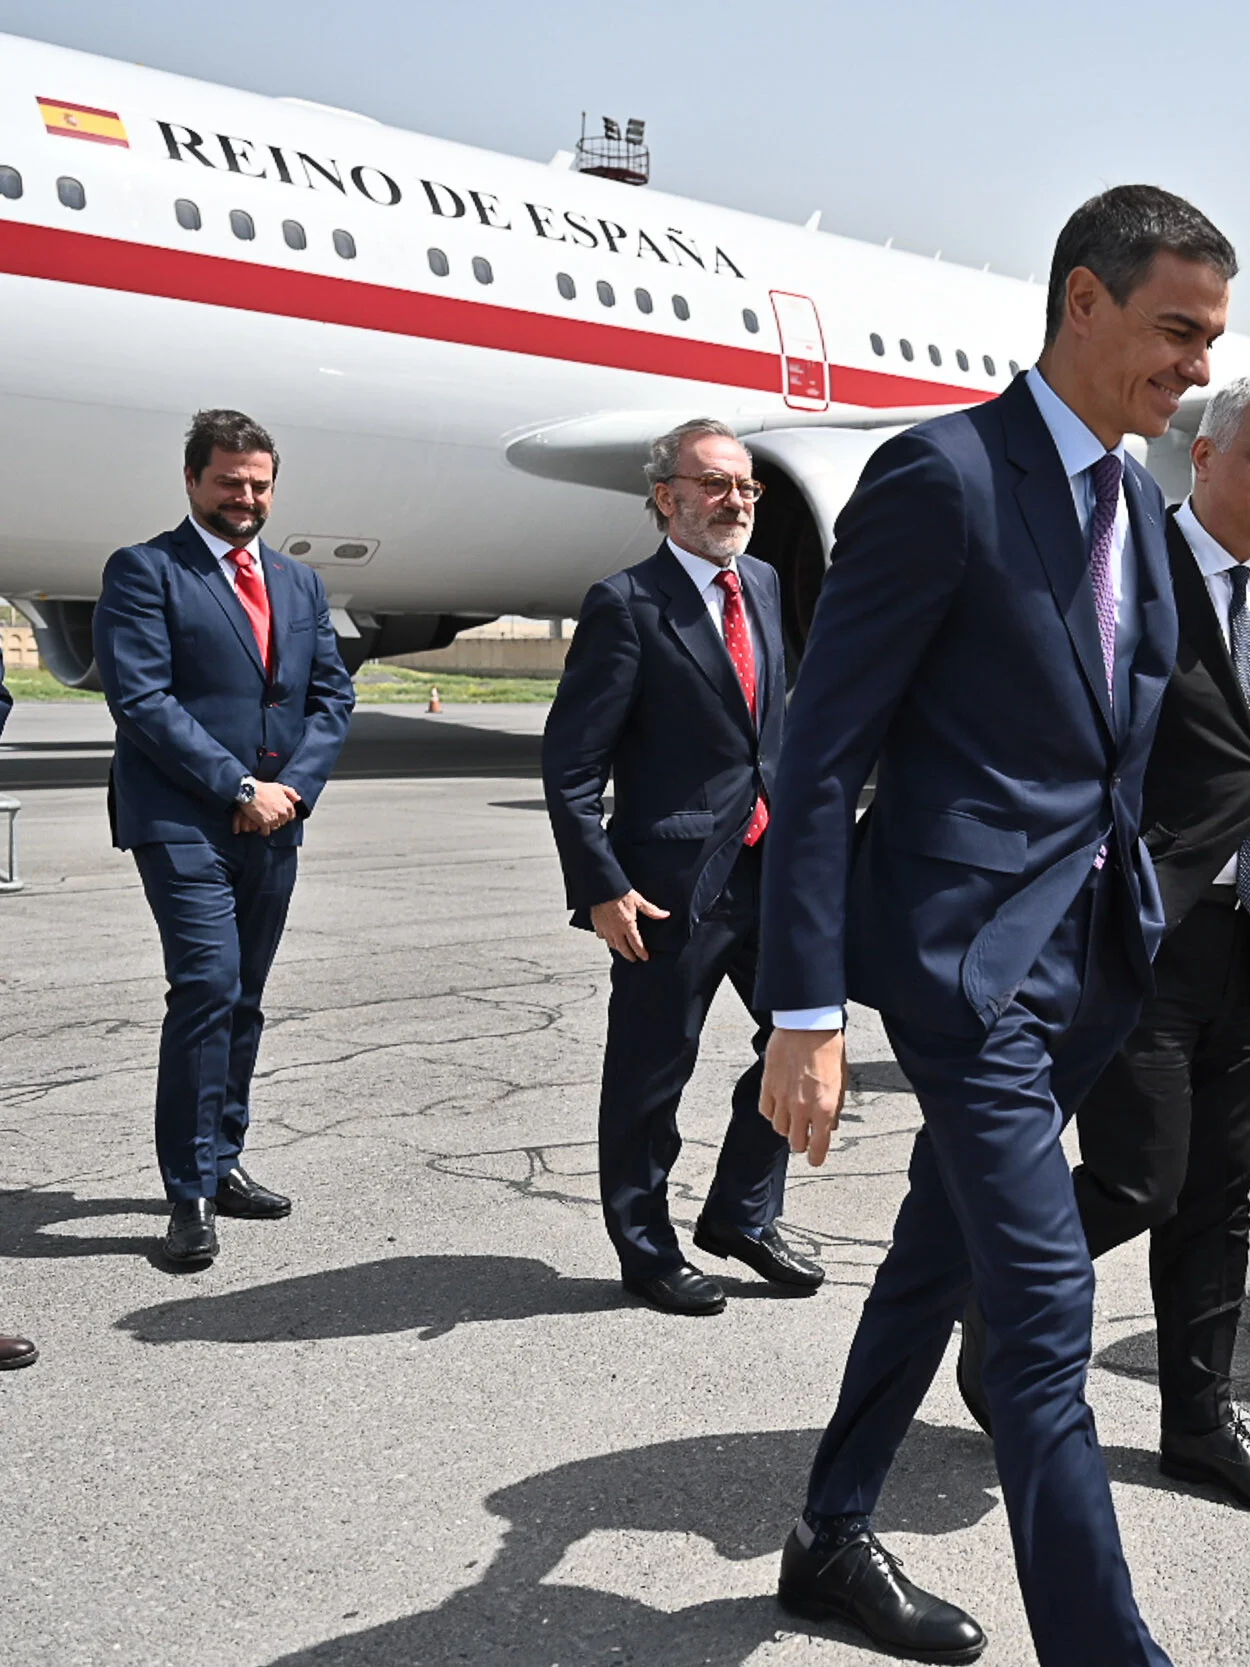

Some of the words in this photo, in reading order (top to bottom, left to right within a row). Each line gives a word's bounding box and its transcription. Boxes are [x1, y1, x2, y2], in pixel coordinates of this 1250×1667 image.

[154, 119, 402, 206] REINO
[419, 178, 511, 231] DE
[521, 201, 747, 280] ESPAÑA
